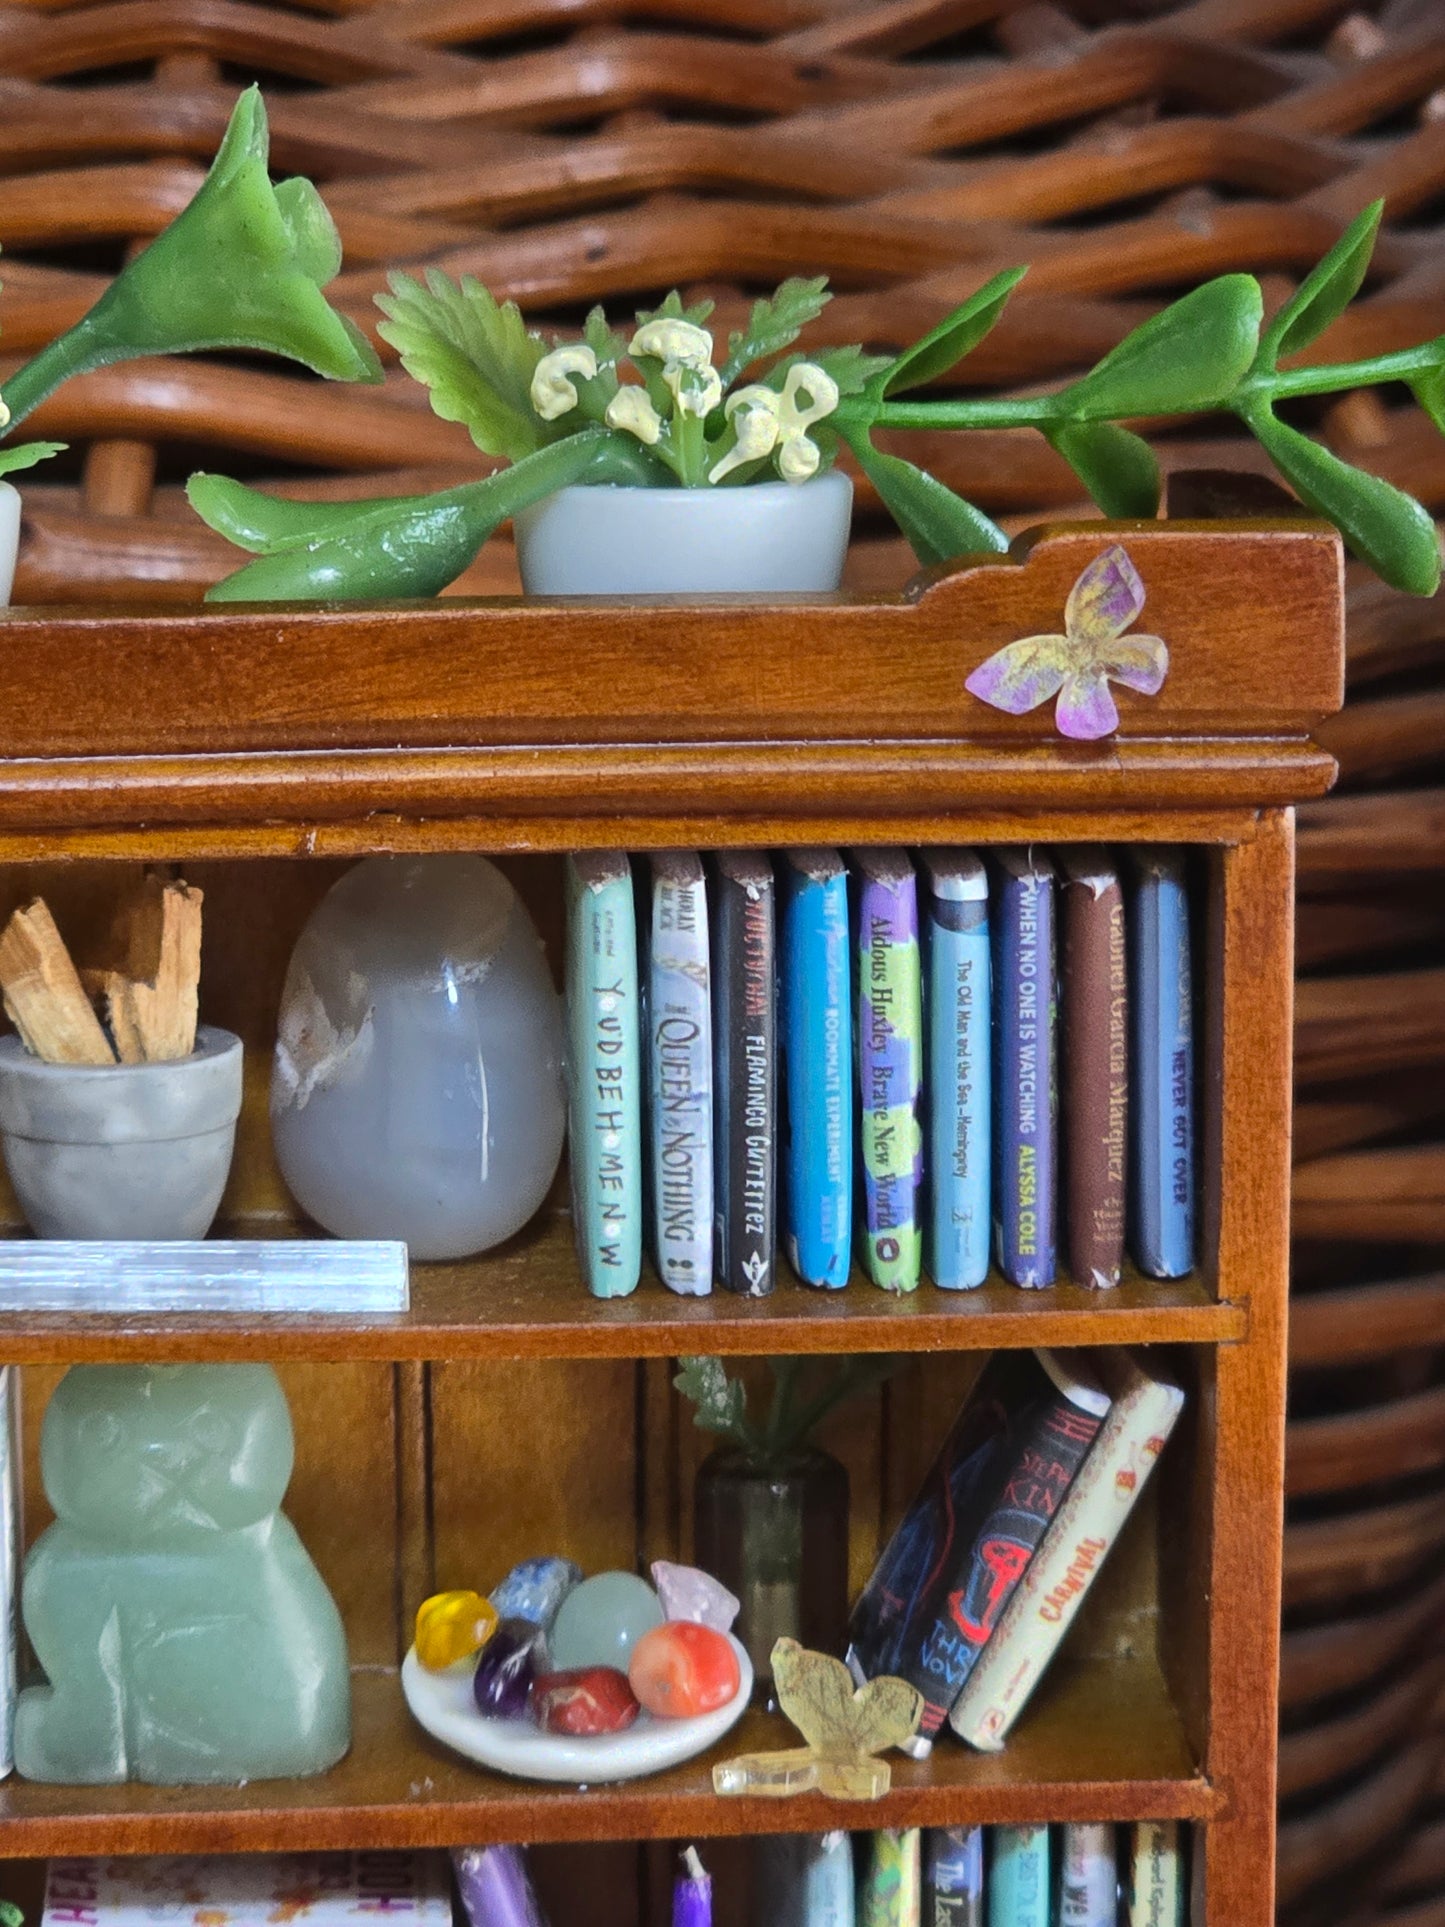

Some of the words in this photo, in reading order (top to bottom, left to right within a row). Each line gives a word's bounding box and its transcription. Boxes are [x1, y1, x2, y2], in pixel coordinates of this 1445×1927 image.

[678, 890, 695, 933] HOLLY
[1019, 891, 1037, 945] WHEN
[870, 915, 893, 982] Aldous
[1019, 950, 1037, 977] NO
[957, 961, 973, 982] The
[957, 986, 973, 1006] Old
[1019, 982, 1037, 1019] ONE
[867, 988, 895, 1053] Huxley
[957, 1010, 971, 1034] Man
[1019, 1024, 1037, 1040] IS
[657, 1019, 700, 1113] QUEEN
[825, 1008, 840, 1090] ROOMMATE
[957, 1038, 971, 1056] and
[595, 1067, 622, 1100] BE
[744, 1036, 767, 1127] FLAMINGO
[871, 1065, 894, 1120] Brave
[957, 1061, 971, 1080] the
[1019, 1044, 1037, 1134] WATCHING
[1172, 1050, 1187, 1108] NEVER
[957, 1084, 971, 1105] Sea
[826, 1096, 841, 1183] EXPERIMENT
[873, 1126, 894, 1166] New
[661, 1129, 706, 1242] NOTHING
[1019, 1145, 1036, 1207] ALYSSA
[875, 1174, 897, 1230] World
[1019, 1211, 1037, 1255] COLE
[1001, 1476, 1056, 1515] KIN
[1039, 1537, 1107, 1622] CARNIVAL
[935, 1862, 964, 1894] The
